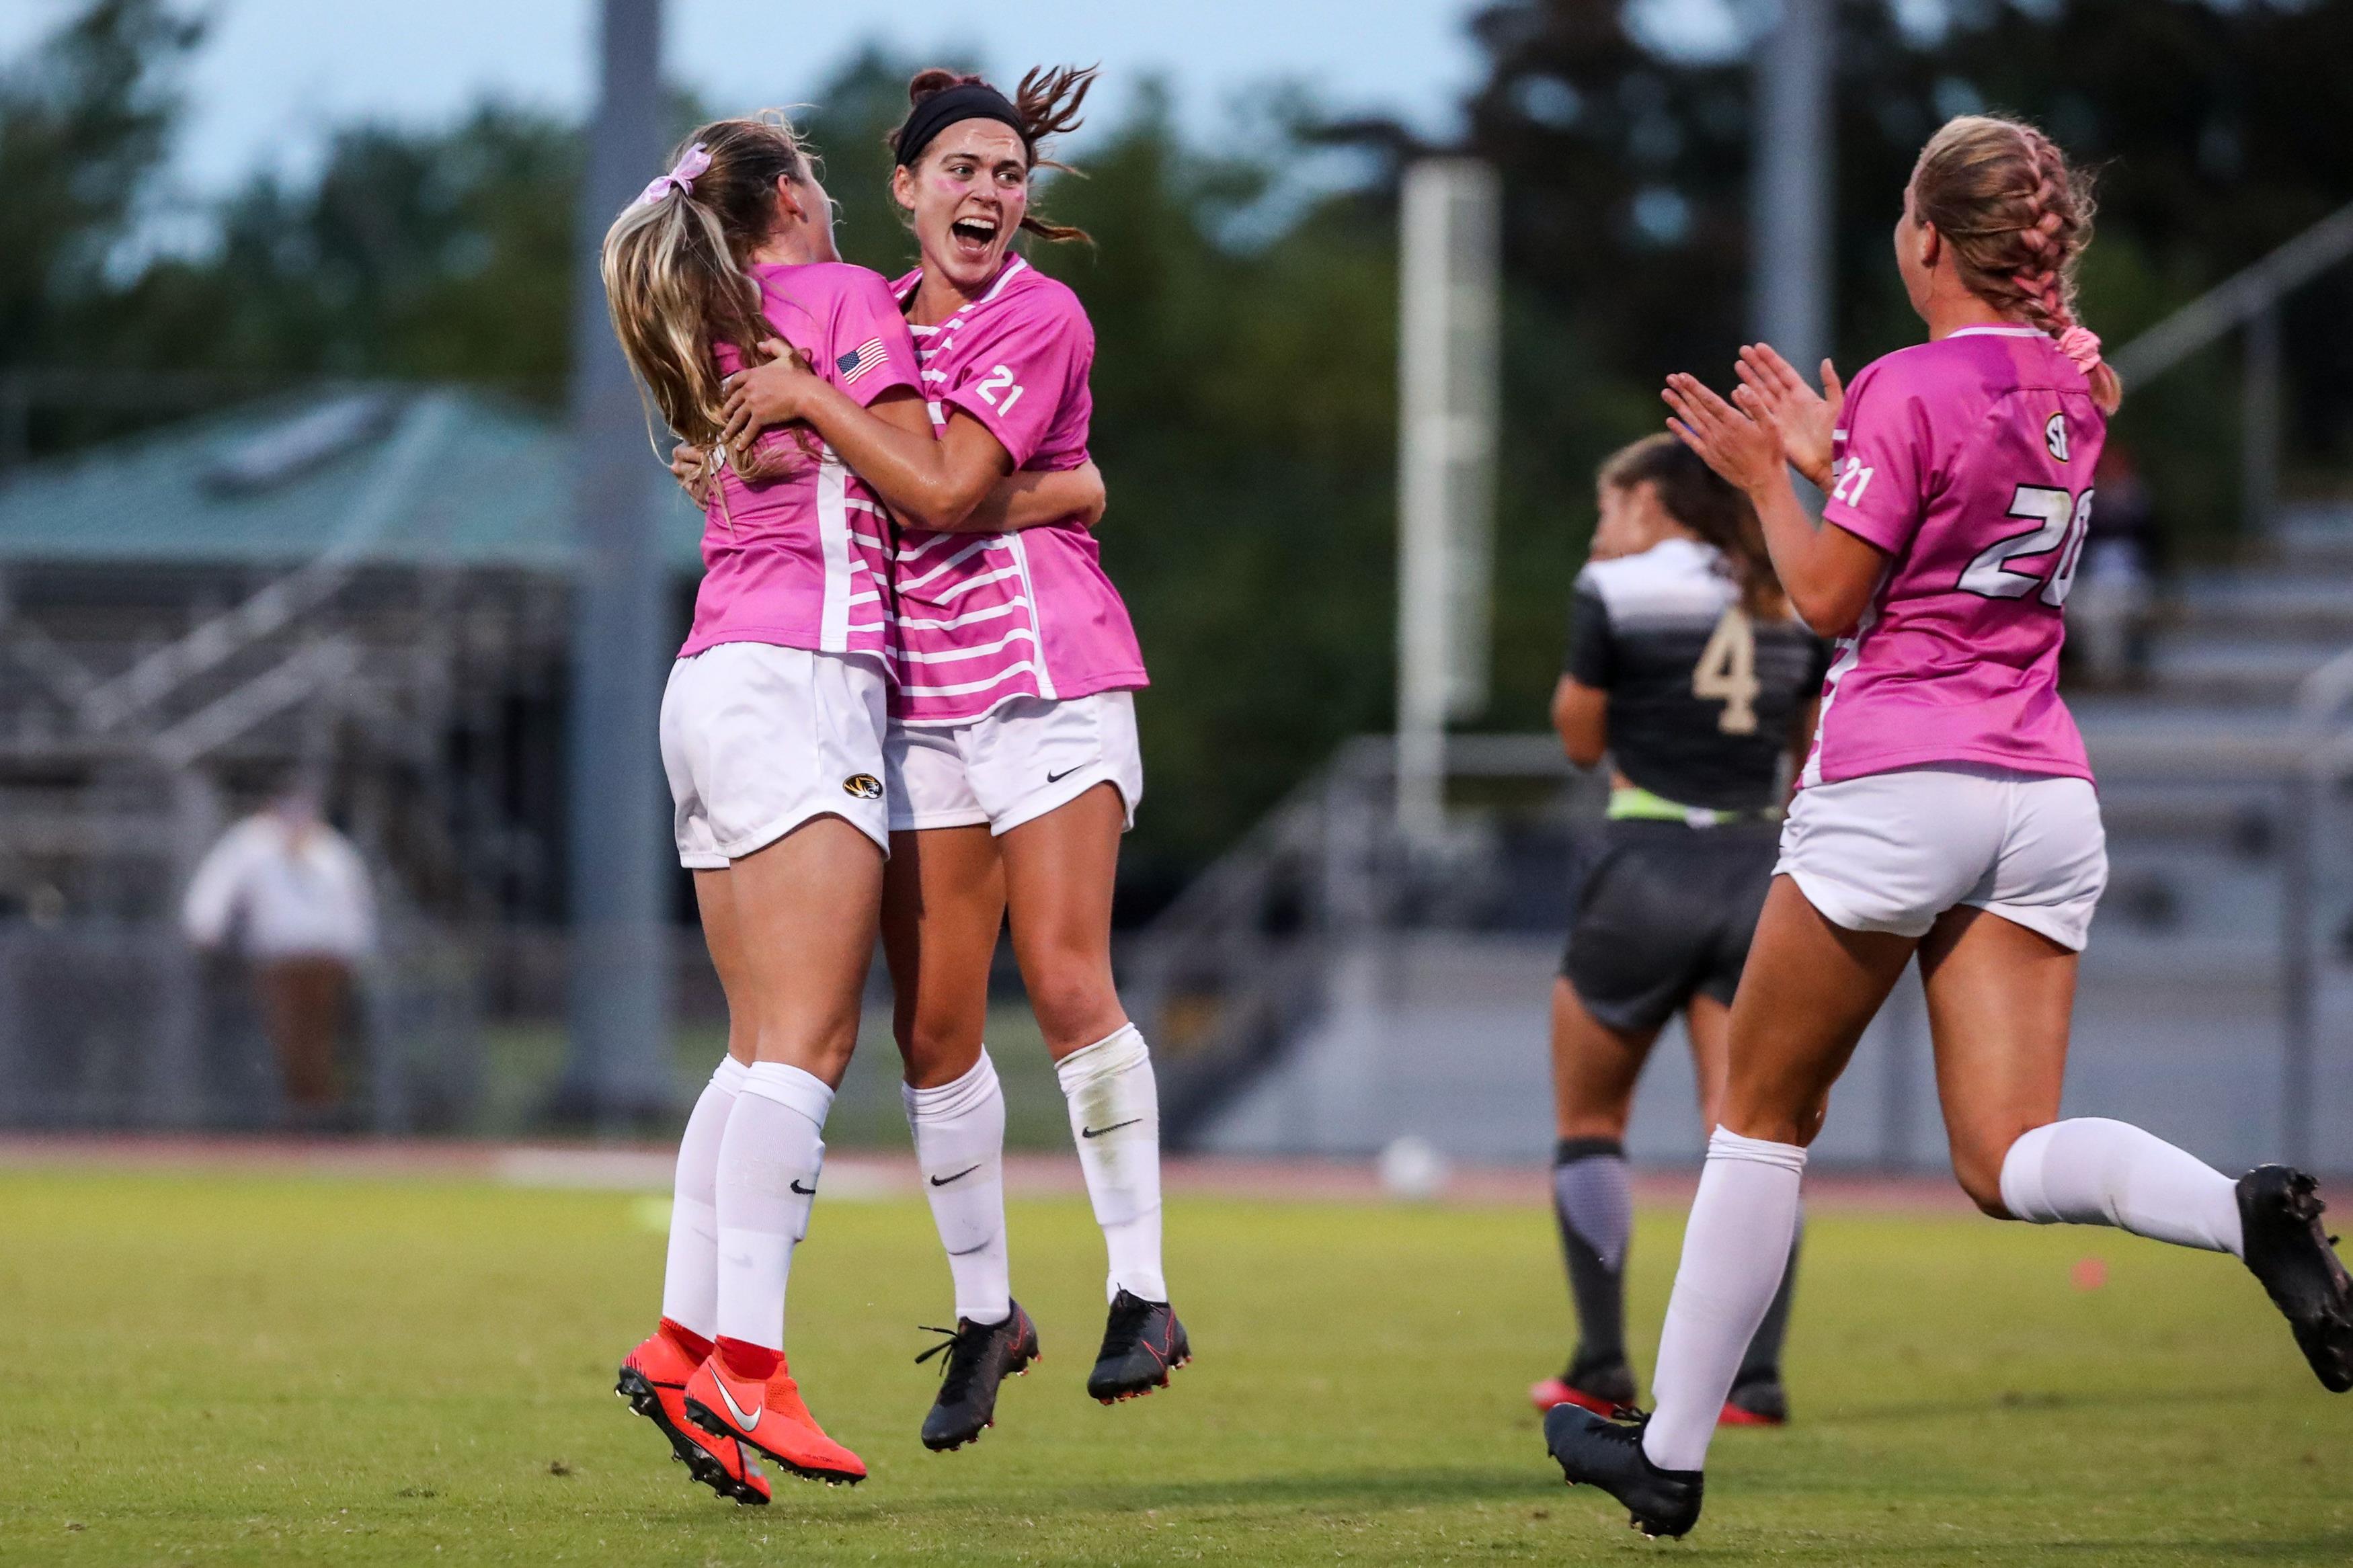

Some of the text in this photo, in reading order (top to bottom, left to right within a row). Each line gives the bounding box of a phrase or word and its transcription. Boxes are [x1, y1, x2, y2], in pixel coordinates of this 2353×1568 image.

[975, 364, 1024, 417] 21
[1833, 456, 1874, 507] 21
[1954, 483, 2094, 608] 20
[1691, 606, 1761, 735] 4
